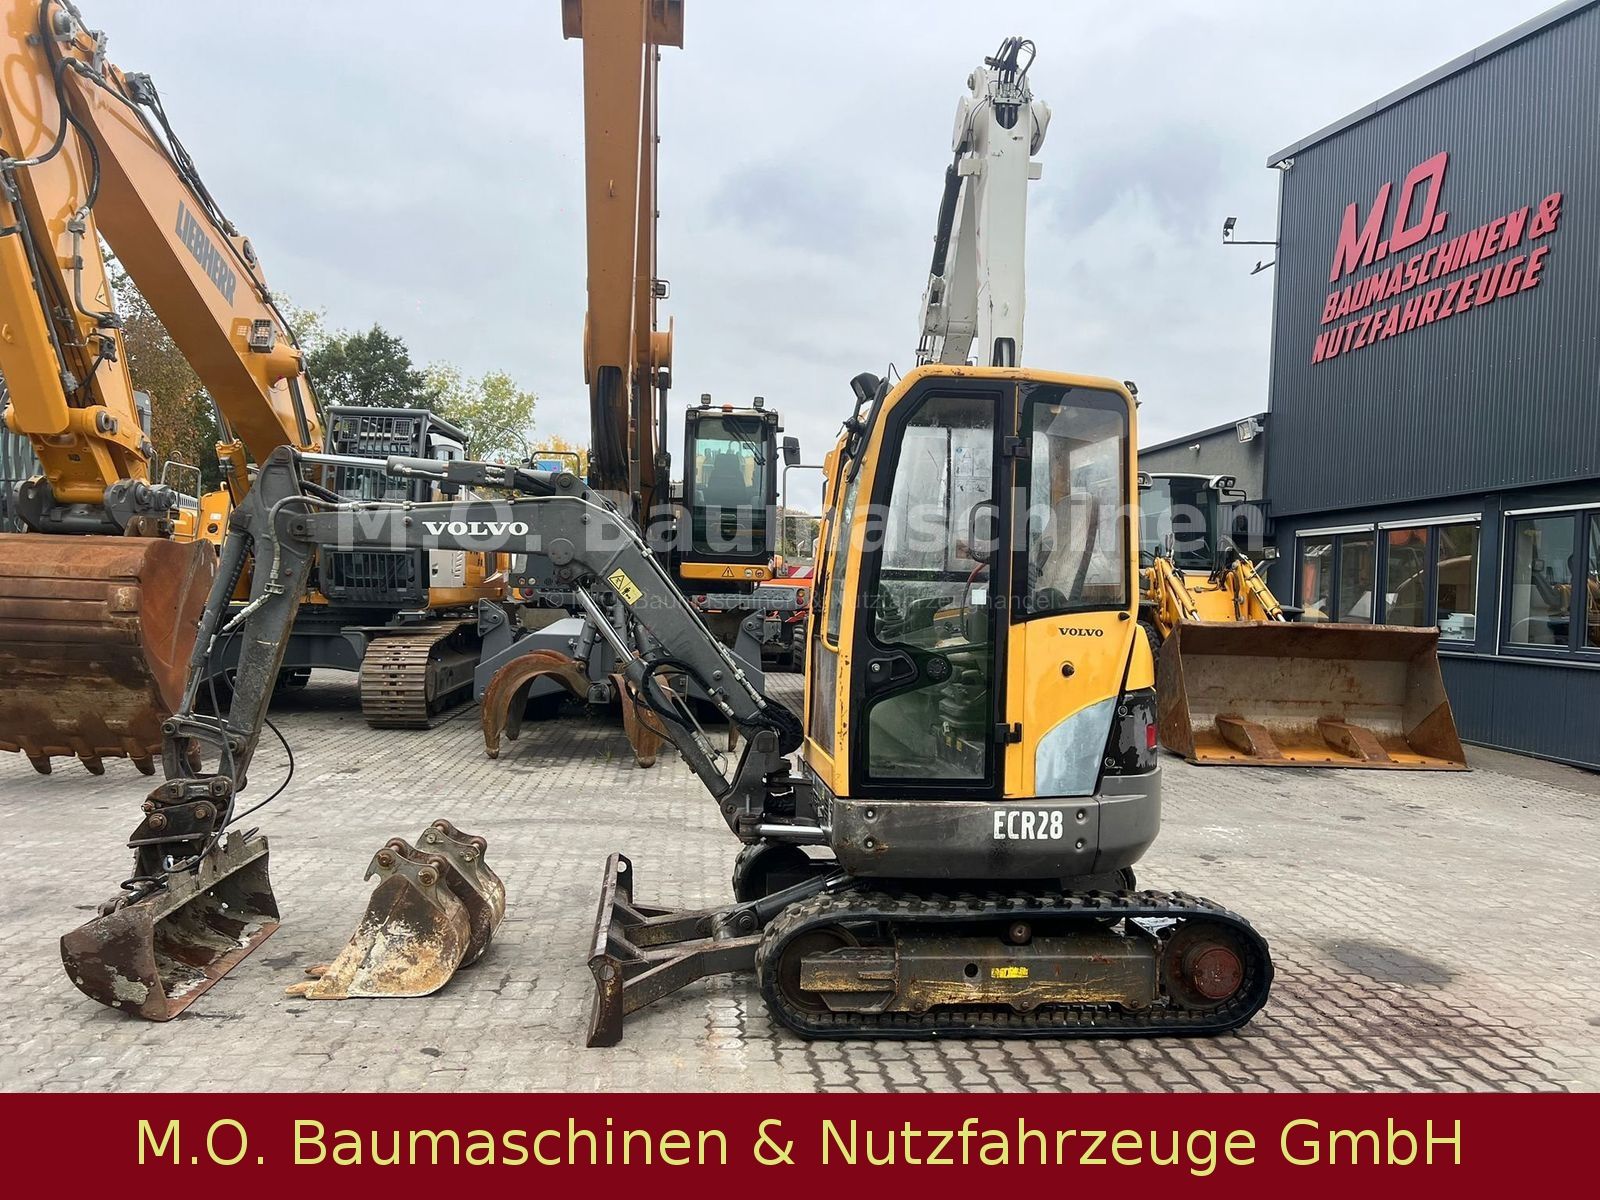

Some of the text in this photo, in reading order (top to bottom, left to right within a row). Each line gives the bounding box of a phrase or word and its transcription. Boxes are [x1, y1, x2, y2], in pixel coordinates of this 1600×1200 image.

[175, 199, 236, 309] LIEBHERR
[1320, 191, 1562, 325] BAUMASCHINEN &
[1329, 151, 1449, 283] M.O.
[1311, 244, 1549, 365] NUTZFAHRZEUGE
[422, 521, 529, 536] VOLVO
[1059, 628, 1104, 637] VOLVO
[992, 809, 1065, 840] ECR28
